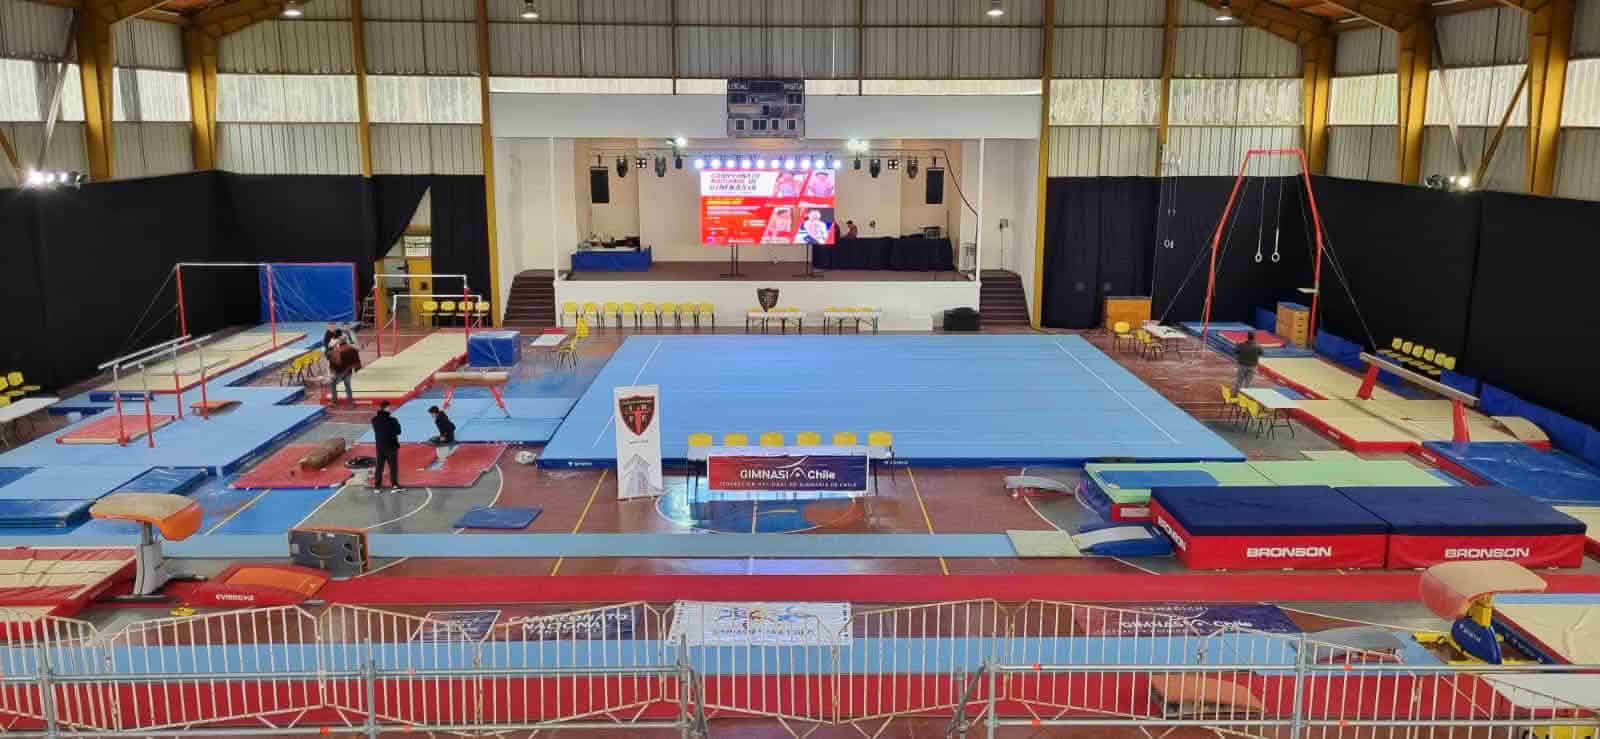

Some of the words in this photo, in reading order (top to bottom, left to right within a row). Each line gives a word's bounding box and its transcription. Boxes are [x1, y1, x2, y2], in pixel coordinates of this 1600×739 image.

[807, 469, 836, 480] Chile
[1246, 546, 1332, 558] BRONSON
[1444, 547, 1530, 558] BRONSON
